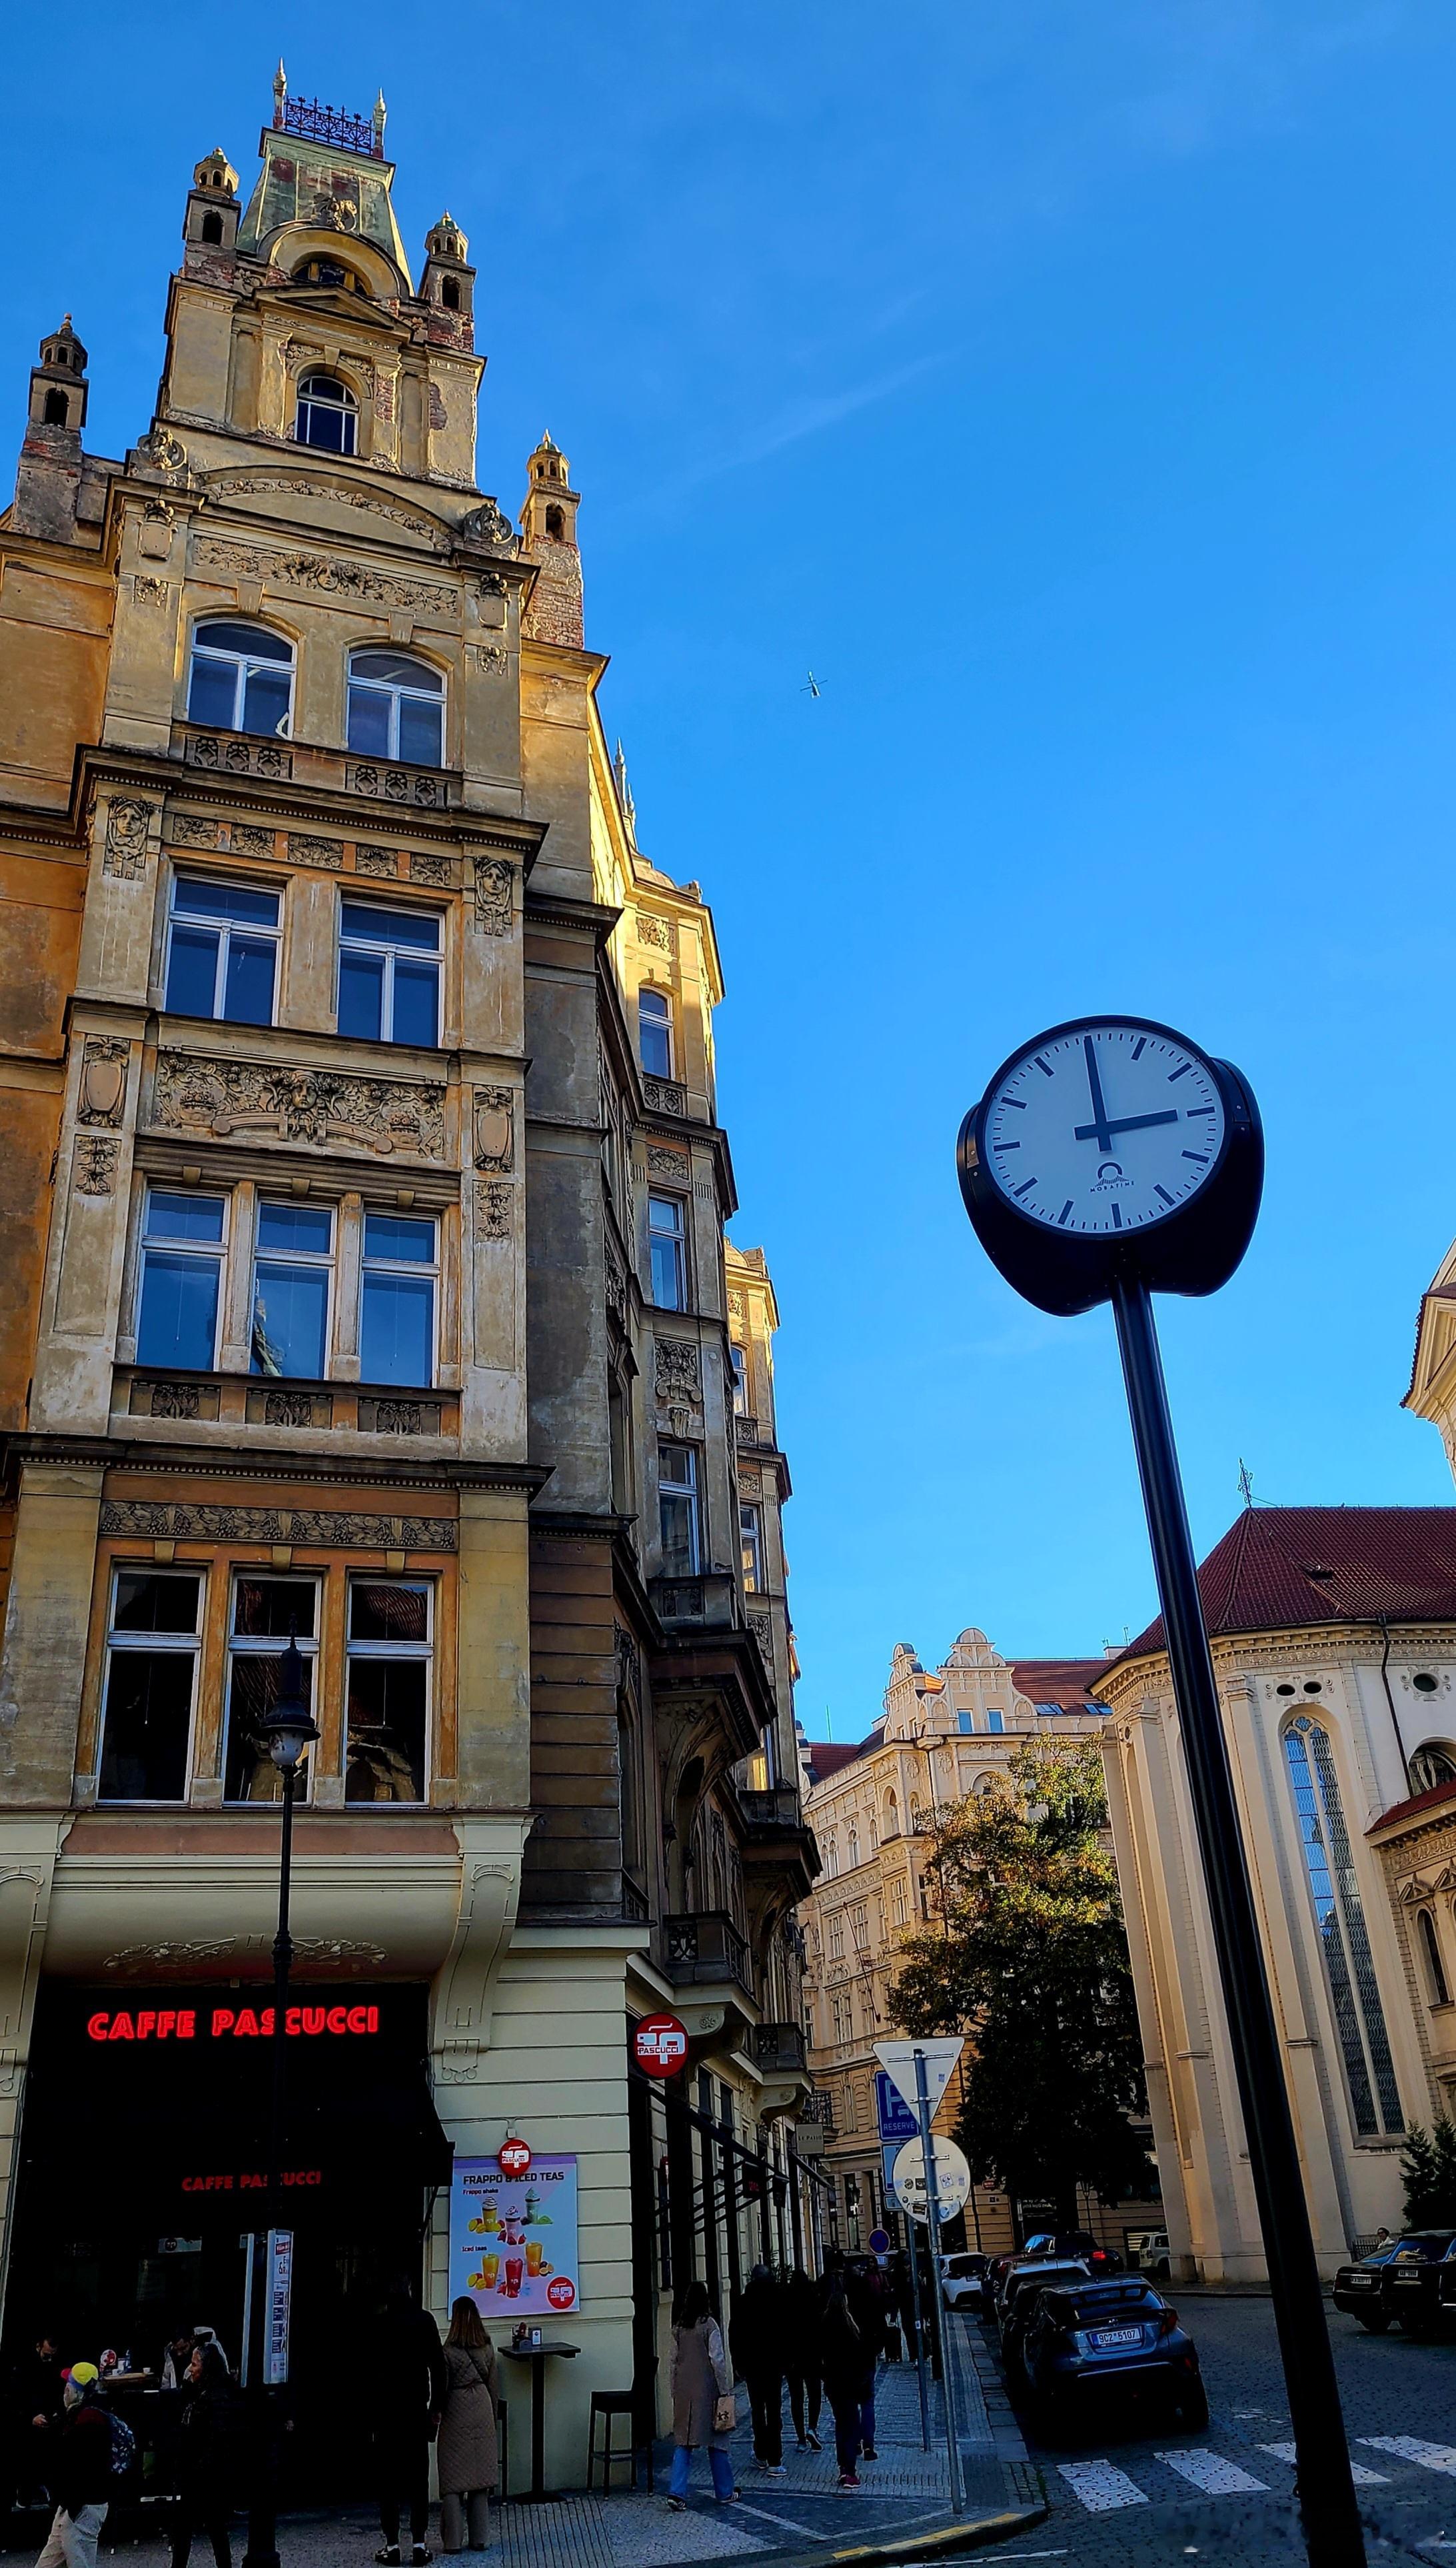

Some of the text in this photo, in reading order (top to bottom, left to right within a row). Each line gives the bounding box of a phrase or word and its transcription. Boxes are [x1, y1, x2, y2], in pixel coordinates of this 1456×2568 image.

[1090, 1180, 1135, 1193] MOBATIME
[88, 2006, 378, 2039] CAFFE PASCUCCI
[181, 2171, 321, 2191] CAFFE PAUCCI
[463, 2174, 503, 2185] FRAPPO
[539, 2171, 564, 2181] TEAS
[1099, 2329, 1135, 2343] 9C2 5107
